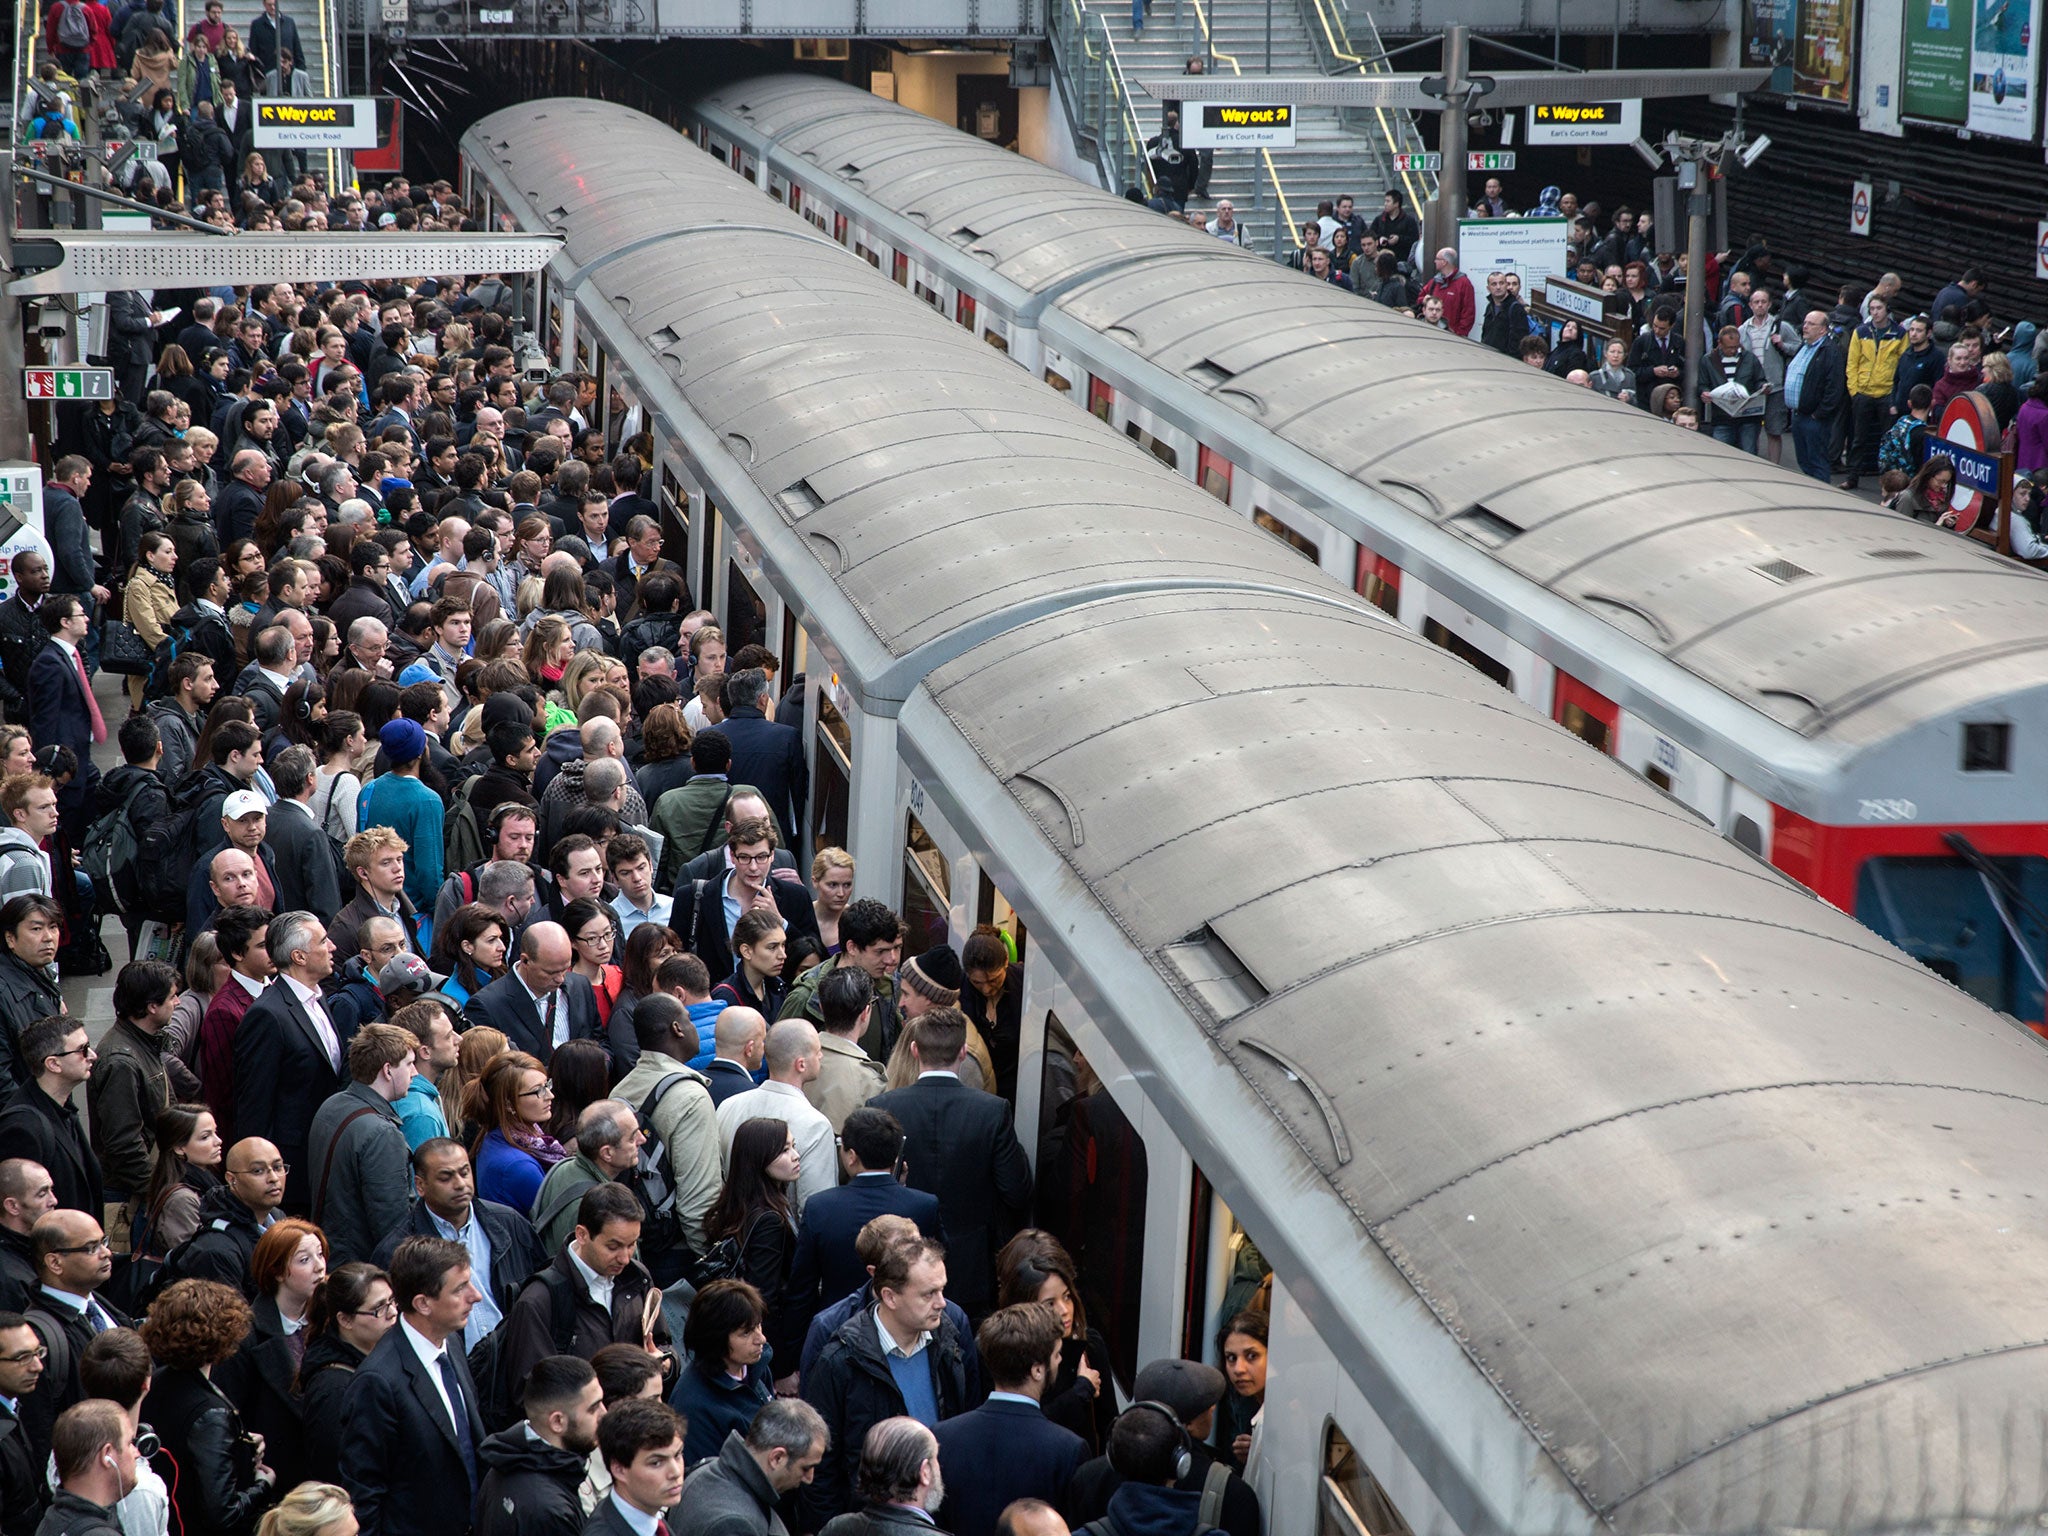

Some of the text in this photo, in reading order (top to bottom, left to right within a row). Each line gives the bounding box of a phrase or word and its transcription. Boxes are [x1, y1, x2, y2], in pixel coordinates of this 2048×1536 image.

[384, 9, 405, 19] OFF
[276, 106, 337, 124] Way out
[1220, 109, 1274, 125] Way out
[1552, 106, 1605, 122] Way out
[278, 132, 342, 140] Earl's Court Road
[1573, 295, 1592, 315] COURT
[1959, 456, 1992, 484] COURT
[13, 544, 38, 553] Point
